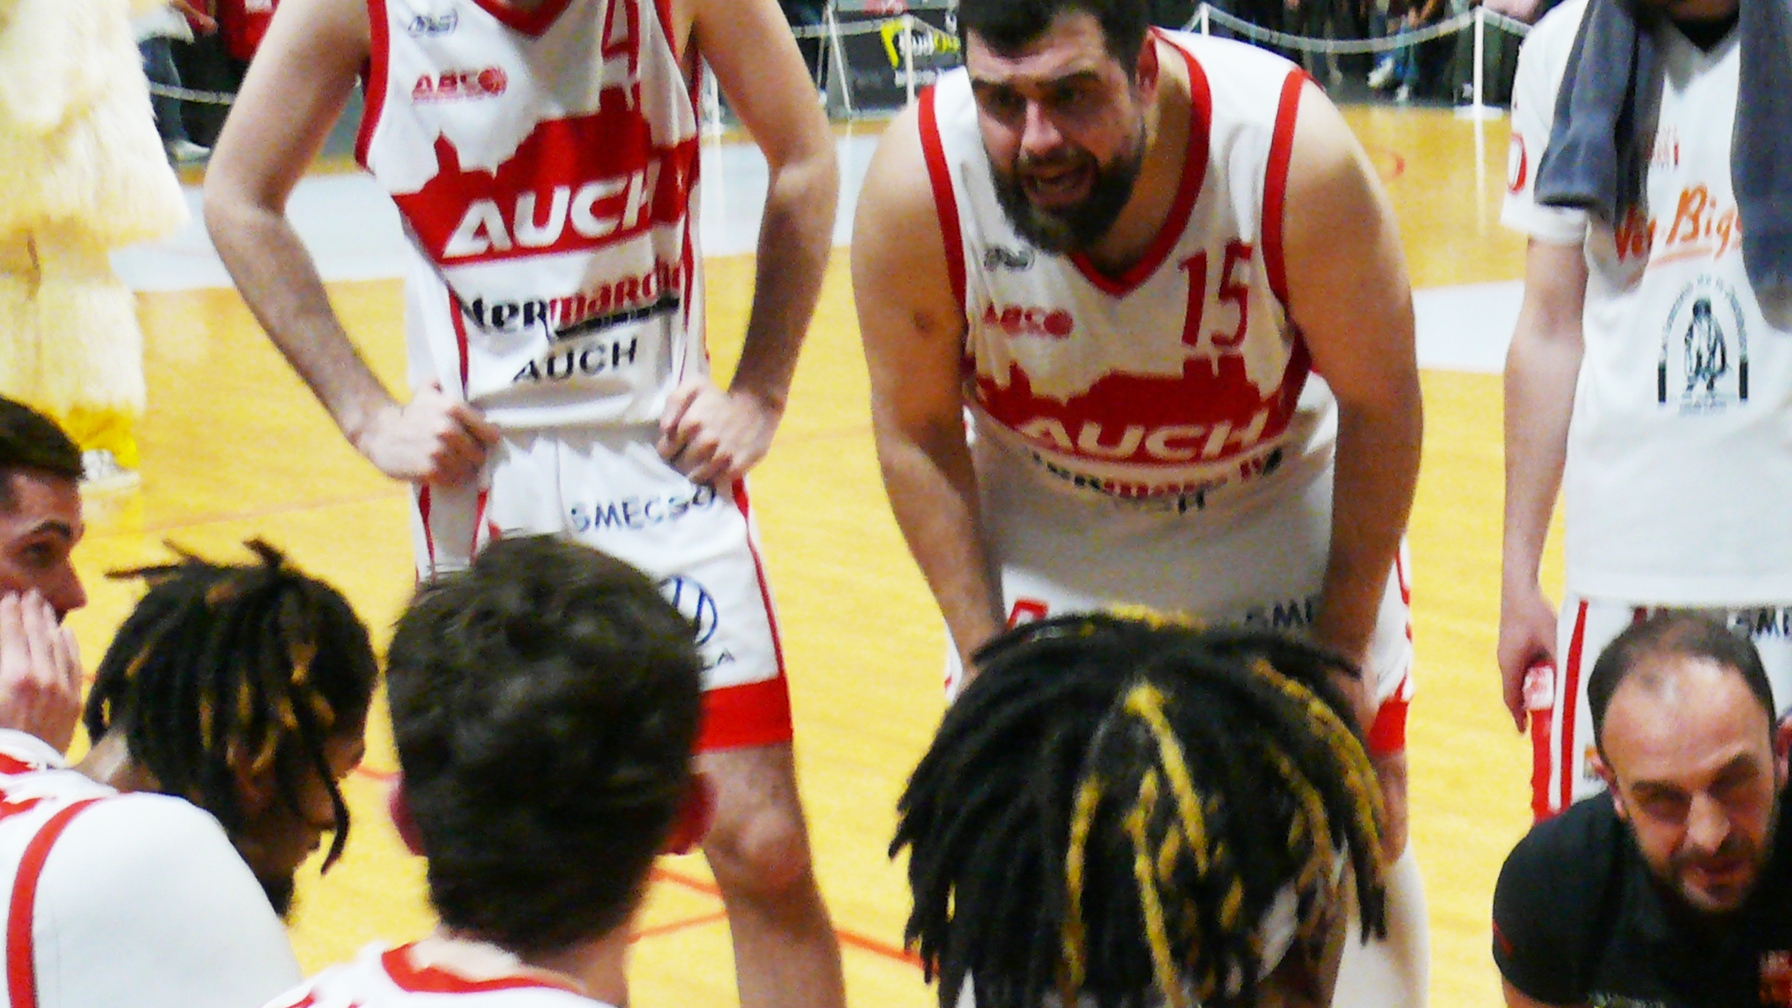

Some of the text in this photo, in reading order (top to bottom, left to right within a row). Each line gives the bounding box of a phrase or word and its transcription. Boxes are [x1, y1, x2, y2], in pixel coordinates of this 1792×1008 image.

[1177, 237, 1253, 350] 15
[513, 337, 638, 384] AUCH
[1014, 406, 1272, 462] AUCH
[570, 481, 717, 533] SMECSO
